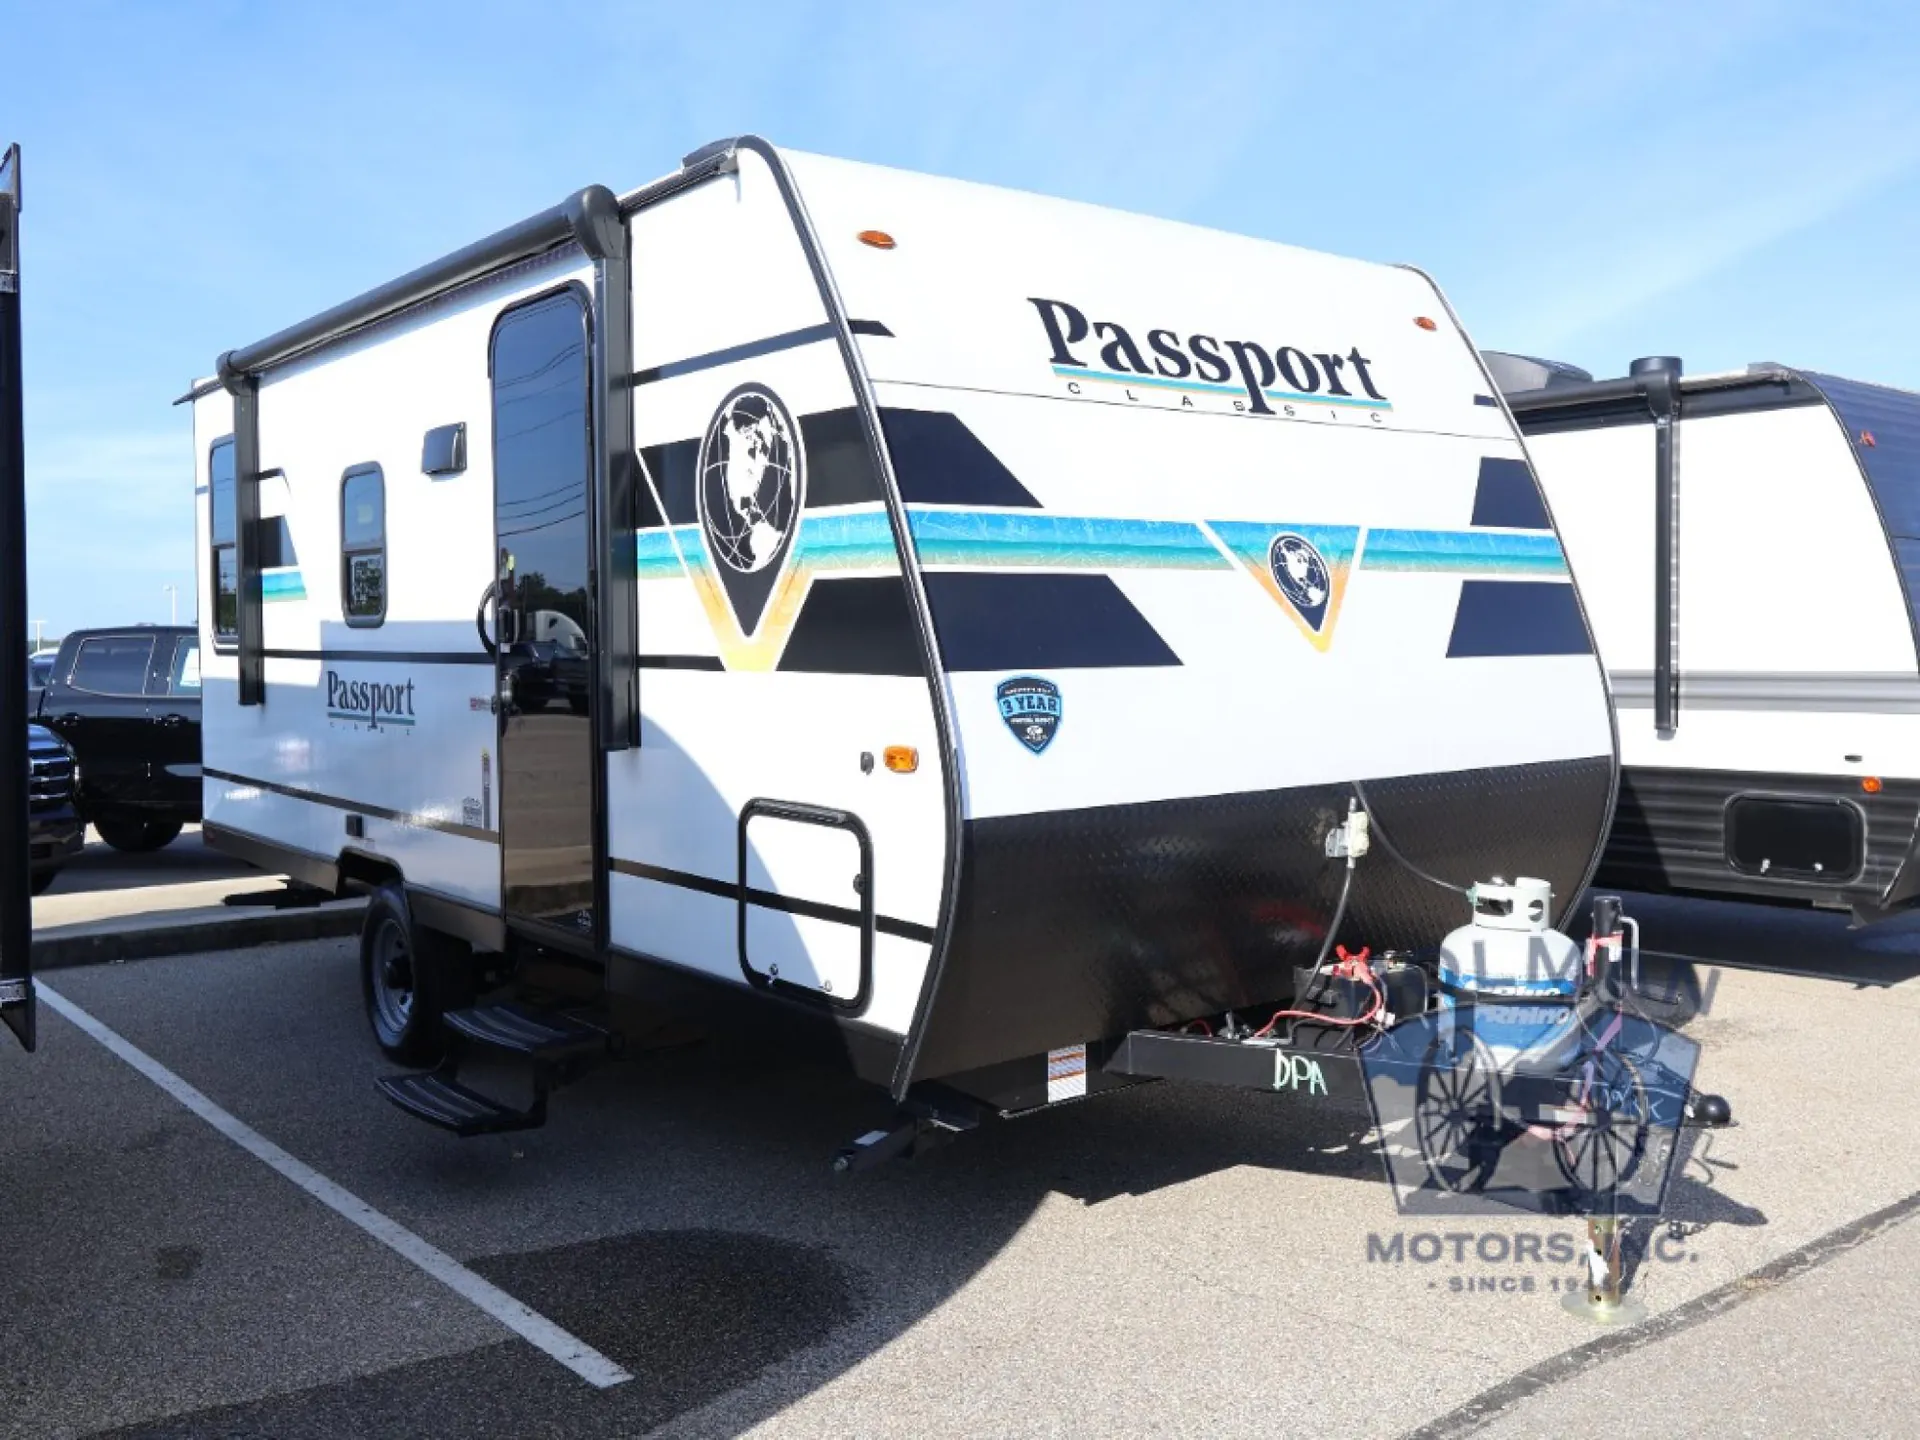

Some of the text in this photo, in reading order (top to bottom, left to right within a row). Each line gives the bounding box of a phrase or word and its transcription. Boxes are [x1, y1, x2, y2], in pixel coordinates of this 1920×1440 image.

[1026, 297, 1388, 415] Passport
[1067, 381, 1383, 424] CLASSIC
[327, 670, 415, 730] Passport
[1015, 695, 1057, 711] YEAR
[1273, 1048, 1328, 1096] DPA
